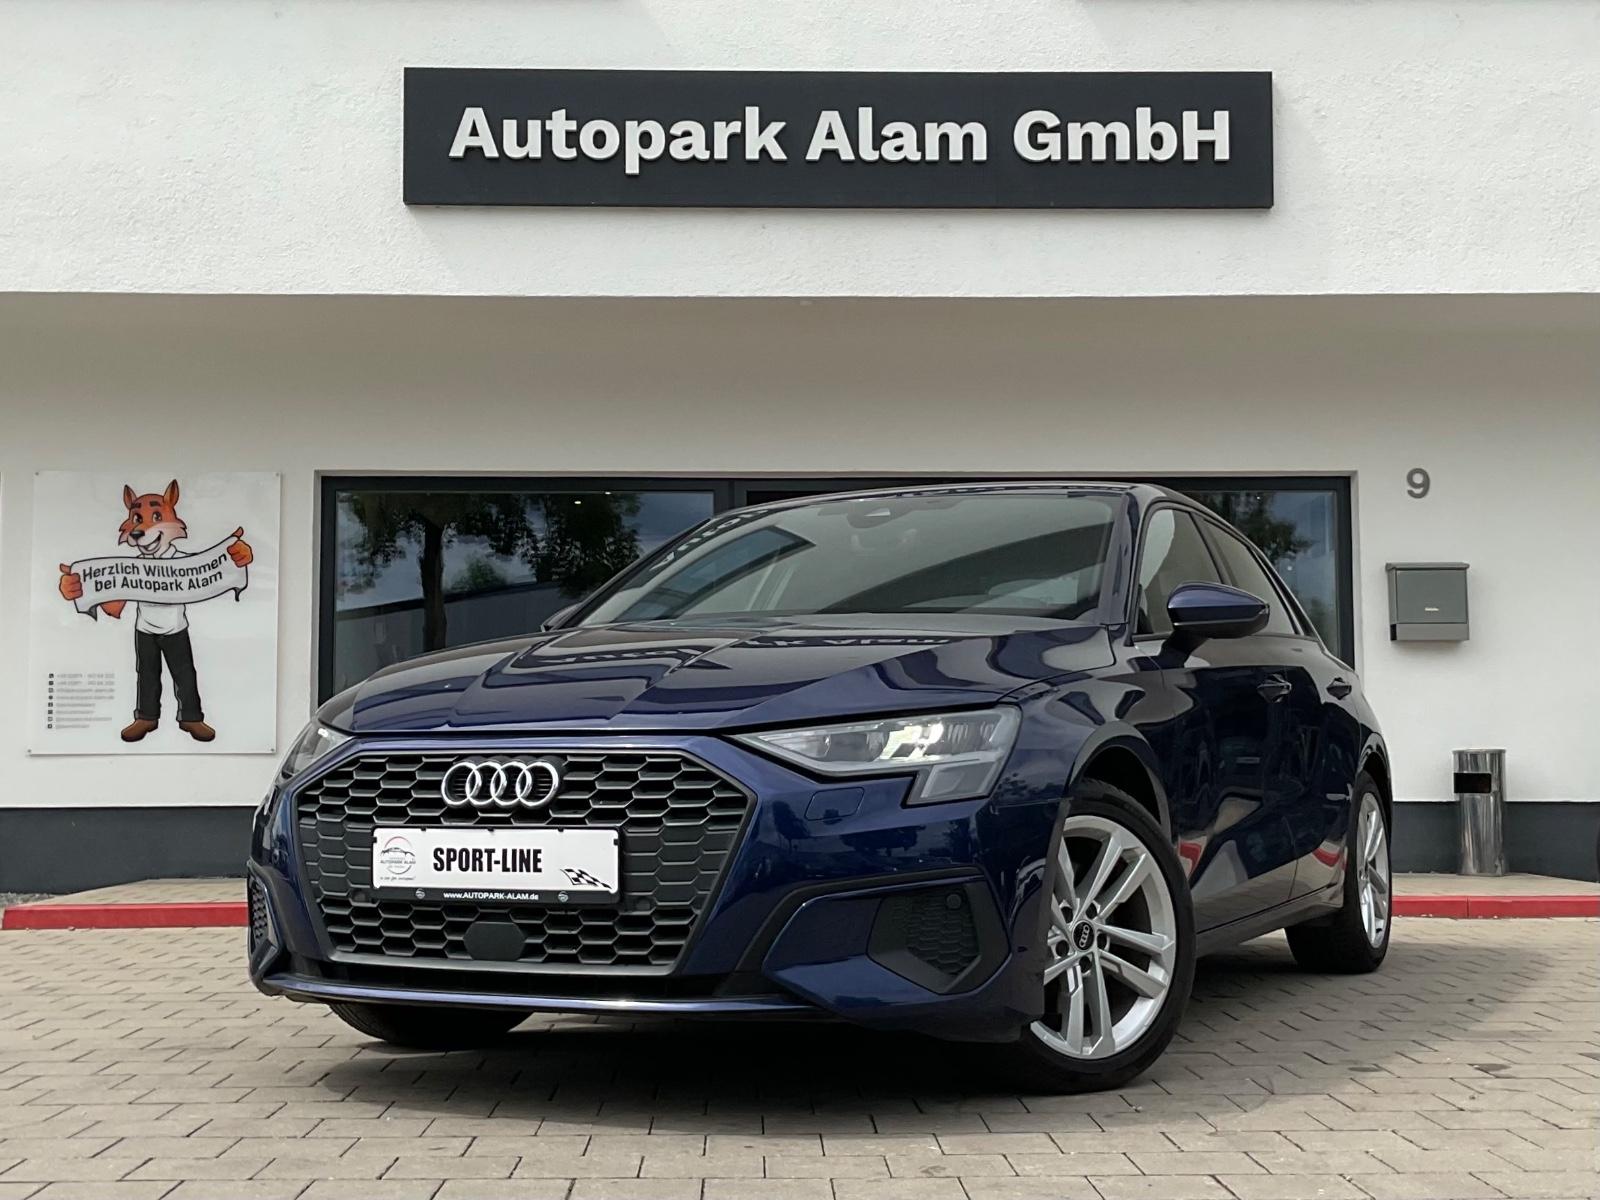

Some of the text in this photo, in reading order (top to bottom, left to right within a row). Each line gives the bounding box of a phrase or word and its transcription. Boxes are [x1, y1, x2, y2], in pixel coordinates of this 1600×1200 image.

[448, 106, 1231, 176] Autopark Alam GmbH
[1406, 467, 1431, 499] 9
[83, 553, 228, 582] Herzlich Willkommen
[94, 571, 223, 592] bei Autopark Alam
[432, 847, 543, 873] SPORT-LINE
[443, 891, 539, 901] www.AUTOPARK-ALAM.de
